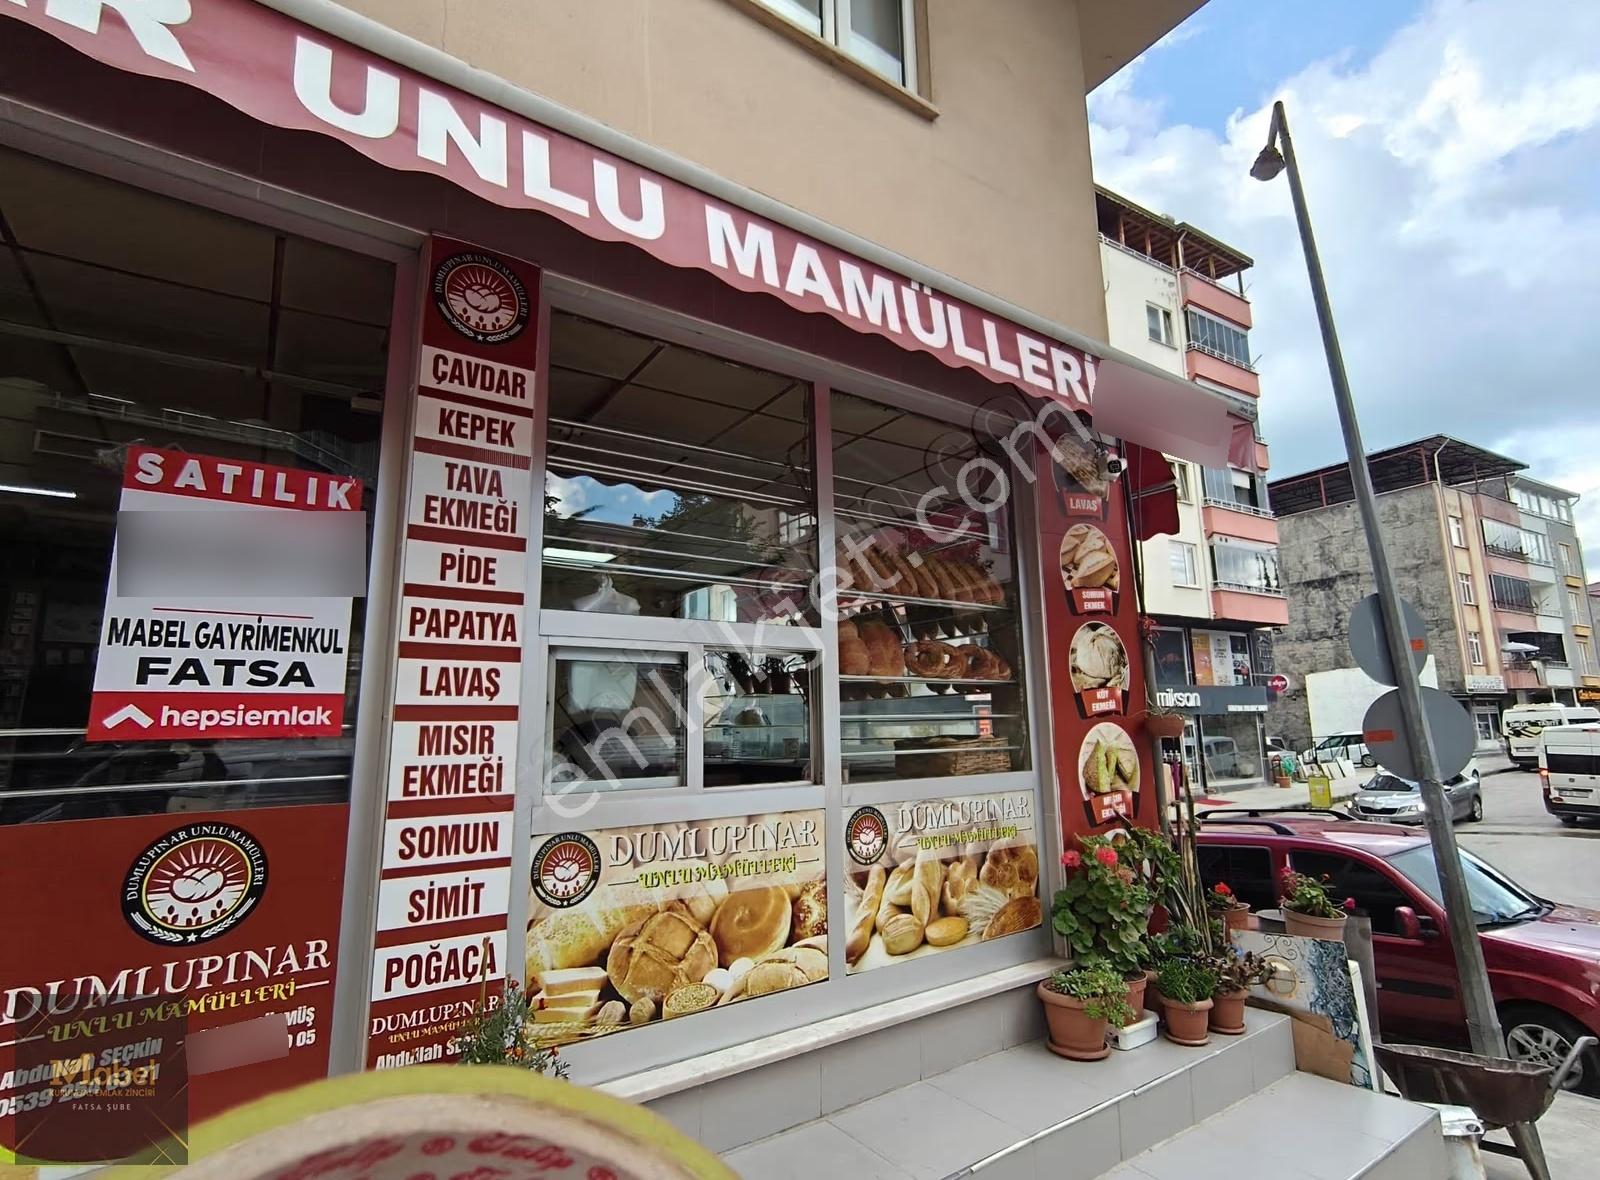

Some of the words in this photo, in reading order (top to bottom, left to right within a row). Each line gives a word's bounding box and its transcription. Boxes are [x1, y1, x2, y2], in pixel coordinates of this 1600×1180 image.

[292, 35, 666, 240] UNLU
[432, 353, 527, 400] ÇAVDAR
[438, 407, 517, 448] KEPEK
[134, 452, 353, 510] SATILIK
[444, 461, 504, 498] TAVA
[423, 494, 518, 534] EKMEĞİ
[439, 548, 497, 586] PİDE
[107, 617, 190, 649] MABEL
[195, 615, 343, 654] GAYRİMENKUL
[408, 606, 517, 642] PAPATYA
[136, 657, 315, 688] FATSA
[419, 666, 501, 701] LAVAŞ
[160, 704, 332, 731] hepsiemlak
[417, 724, 495, 757] MISIR
[402, 755, 503, 798] EKMEĞİ
[898, 795, 1031, 833] DUMLUPINAR
[398, 821, 500, 861] SOMUN
[609, 818, 820, 868] DUMLUPINAR
[127, 830, 188, 900] DUMLUPINAR
[191, 825, 229, 837] UNLU
[407, 876, 485, 923] SİMİT
[0, 939, 331, 1026] DUMLUPINAR
[384, 943, 498, 993] POĞAÇA
[47, 1011, 133, 1043] UNLU
[137, 977, 298, 1025] MAMÜLLERİ
[371, 995, 500, 1036] DUMLUPINR
[100, 1037, 163, 1067] SEÇKİN
[296, 1029, 316, 1047] 05
